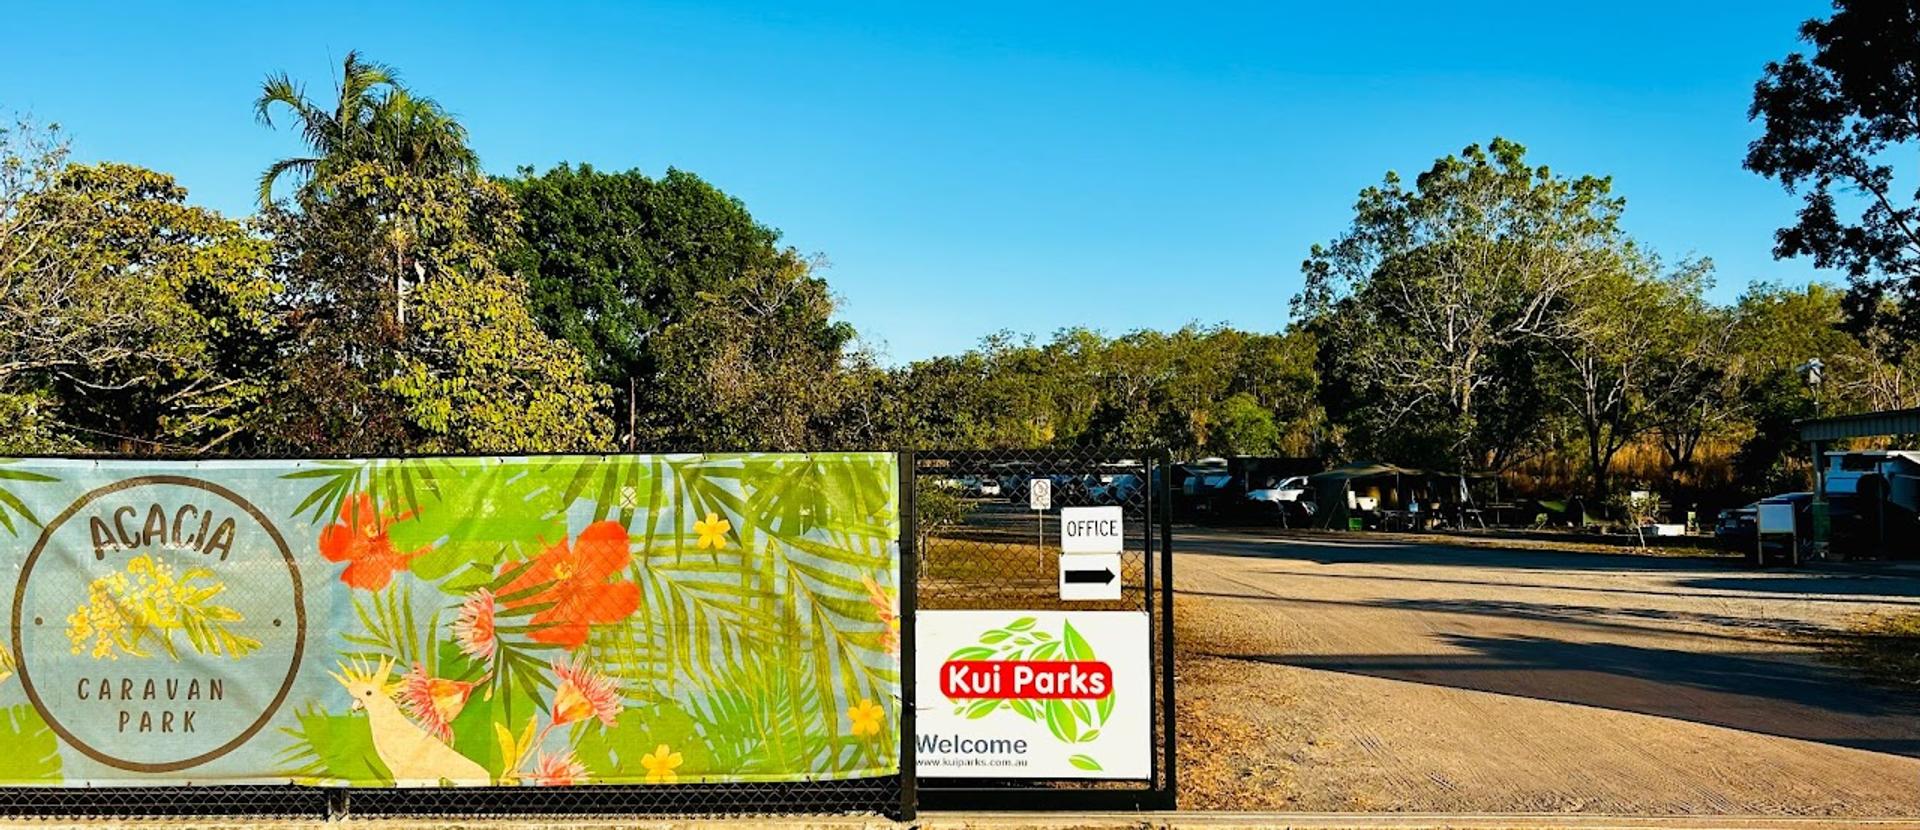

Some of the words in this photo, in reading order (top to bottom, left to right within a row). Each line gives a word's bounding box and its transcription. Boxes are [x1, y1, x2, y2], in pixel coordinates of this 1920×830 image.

[90, 503, 236, 561] ACACIA
[1066, 519, 1119, 537] OFFICE
[78, 678, 223, 700] CARAVAN
[949, 665, 1001, 693] Kui
[1014, 664, 1106, 694] Parks
[119, 711, 197, 733] PARK
[916, 733, 1028, 754] Welcome
[916, 757, 1028, 768] www.kuiparks.com.au
